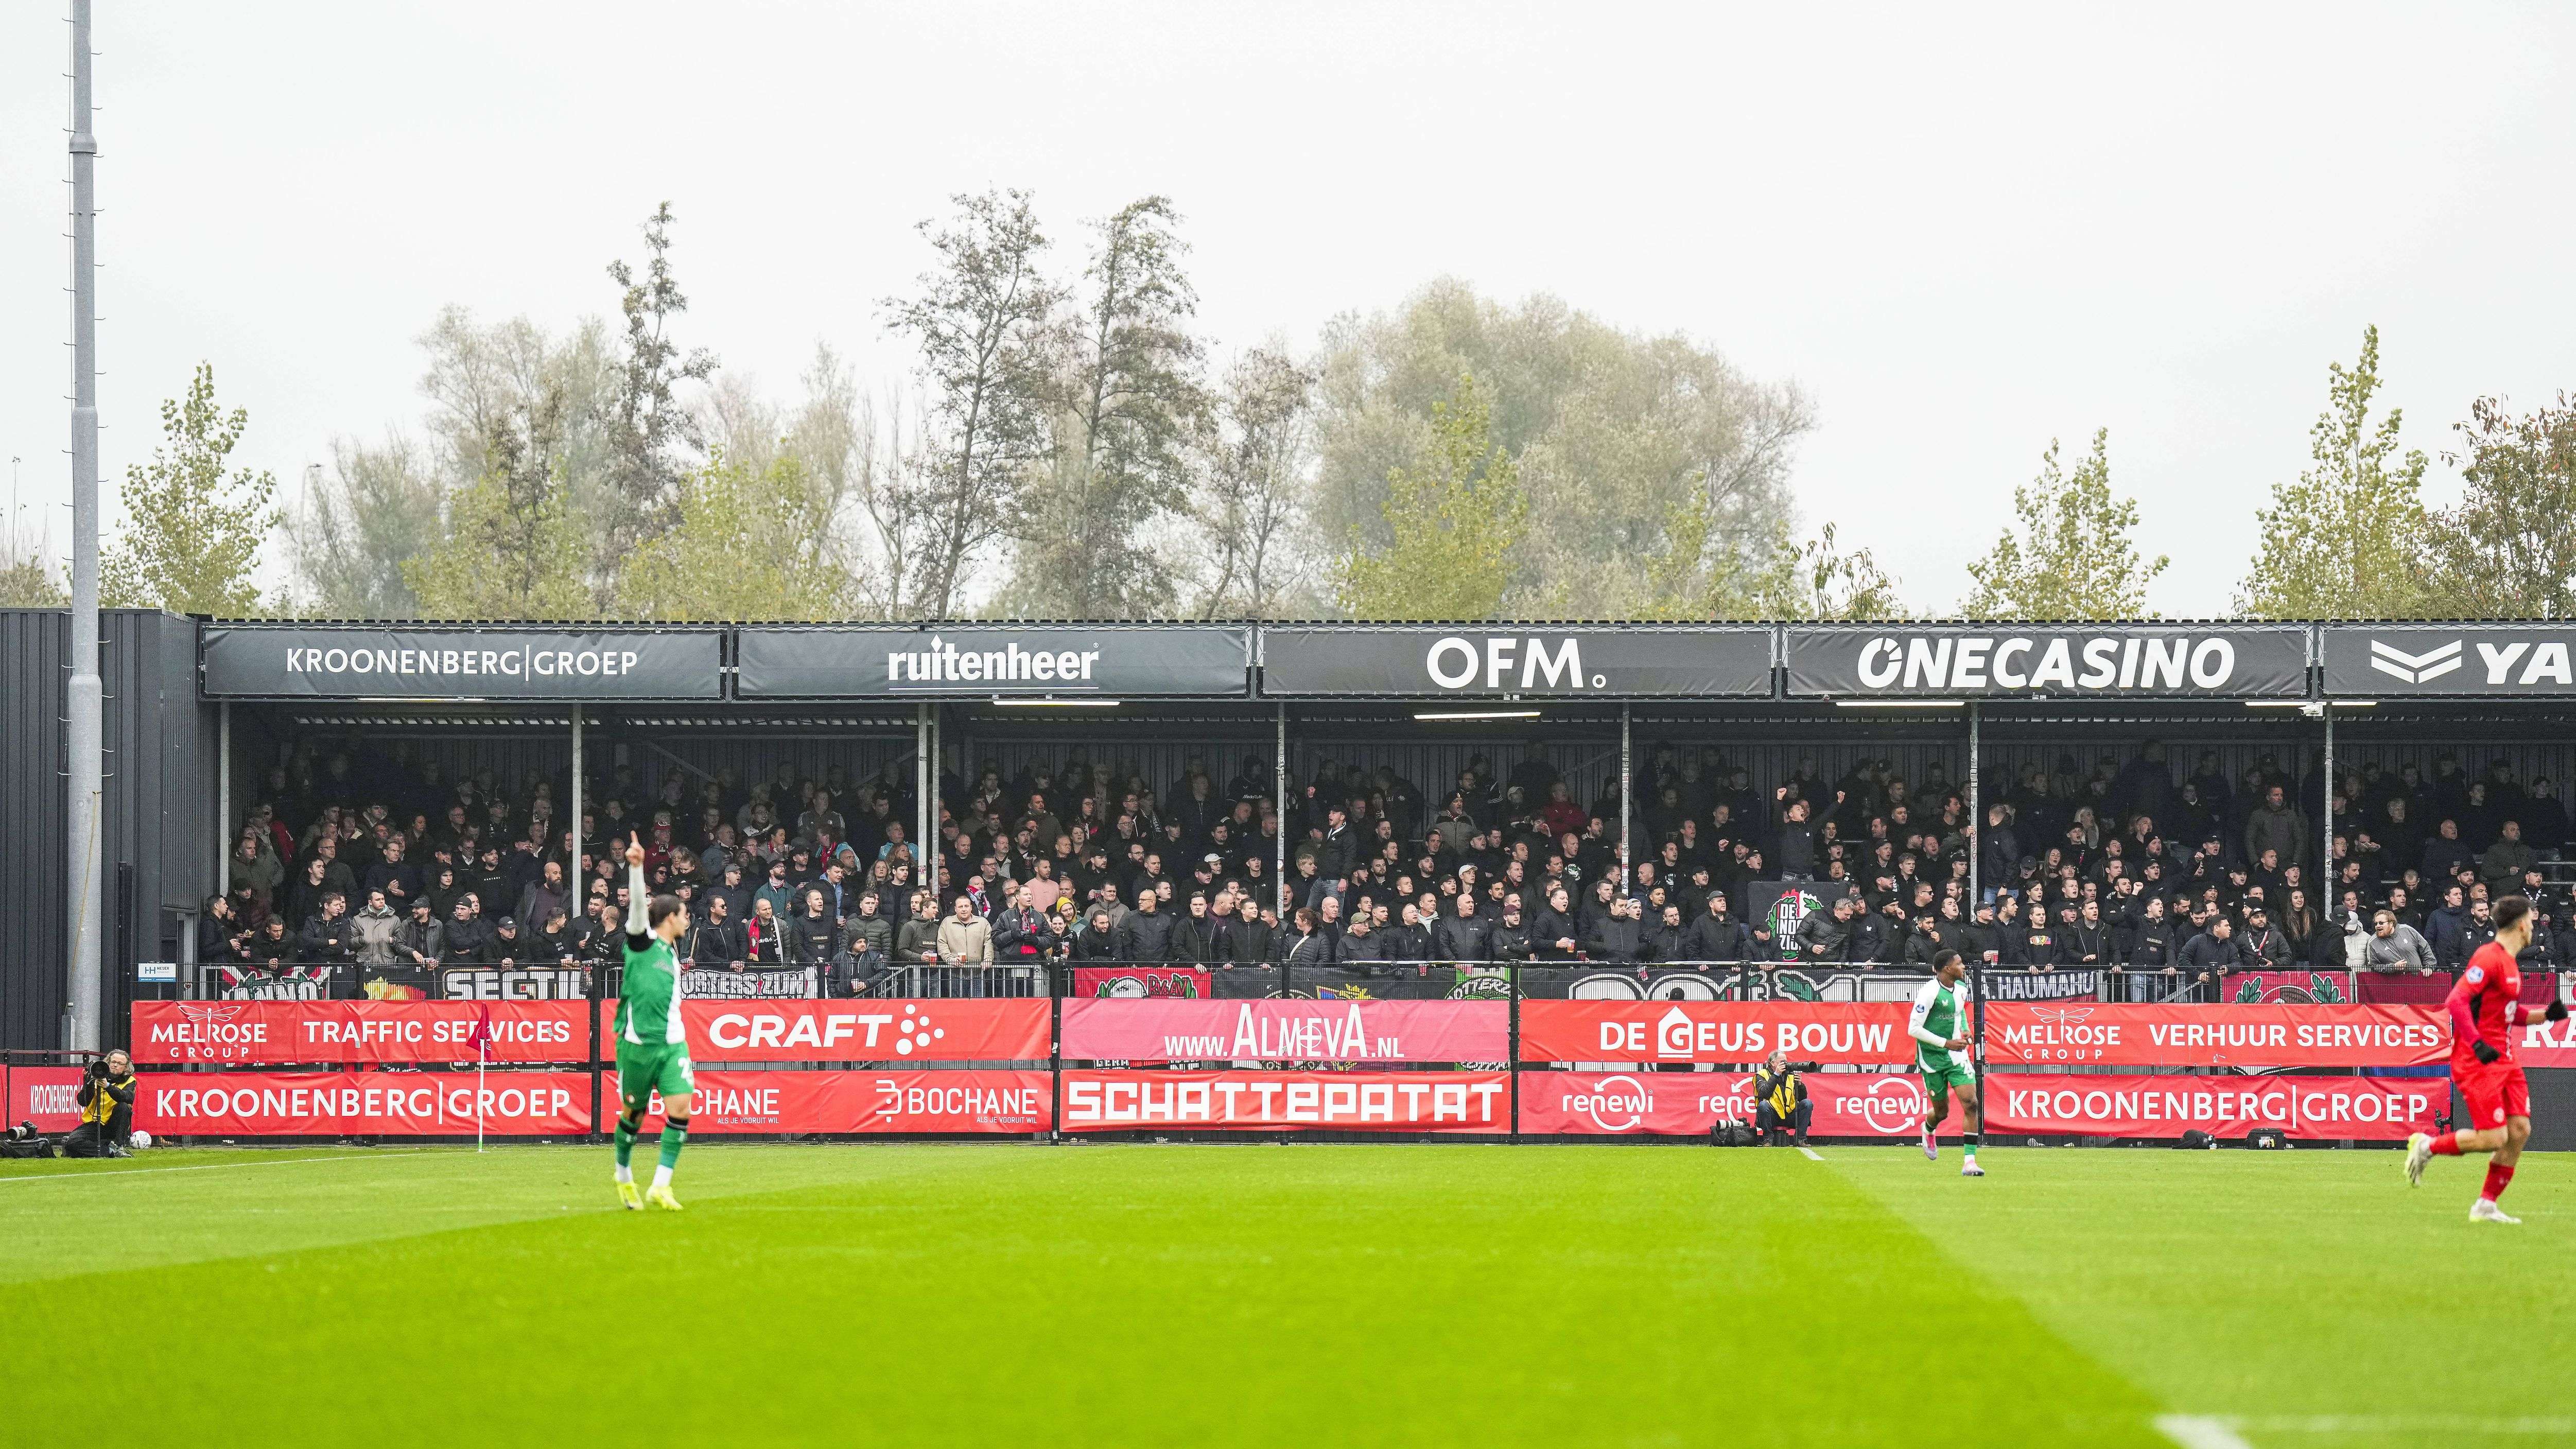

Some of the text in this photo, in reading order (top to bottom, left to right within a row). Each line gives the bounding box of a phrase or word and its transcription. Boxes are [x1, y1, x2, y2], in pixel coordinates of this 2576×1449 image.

[888, 634, 1099, 680] ruitenheer
[1857, 637, 2235, 689] ONECASINO
[1997, 971, 2094, 1000] HAUMAHU
[151, 1023, 268, 1043] MELROSE
[303, 1021, 423, 1043] TRAFFIC
[709, 1014, 893, 1049] CRAFT
[1600, 1018, 1892, 1055] DE GEUS BOUW
[2004, 1025, 2121, 1045] MELROSE
[2149, 1024, 2440, 1048] VERHUUR SERVICES
[170, 1046, 249, 1058] GROUP
[2024, 1048, 2103, 1060] GROUP
[648, 1088, 780, 1115] BCHANE
[908, 1088, 1038, 1115] BOCHANE
[1562, 1089, 1653, 1113] renewi
[1699, 1095, 1756, 1113] rene
[1836, 1091, 1928, 1115] renewi
